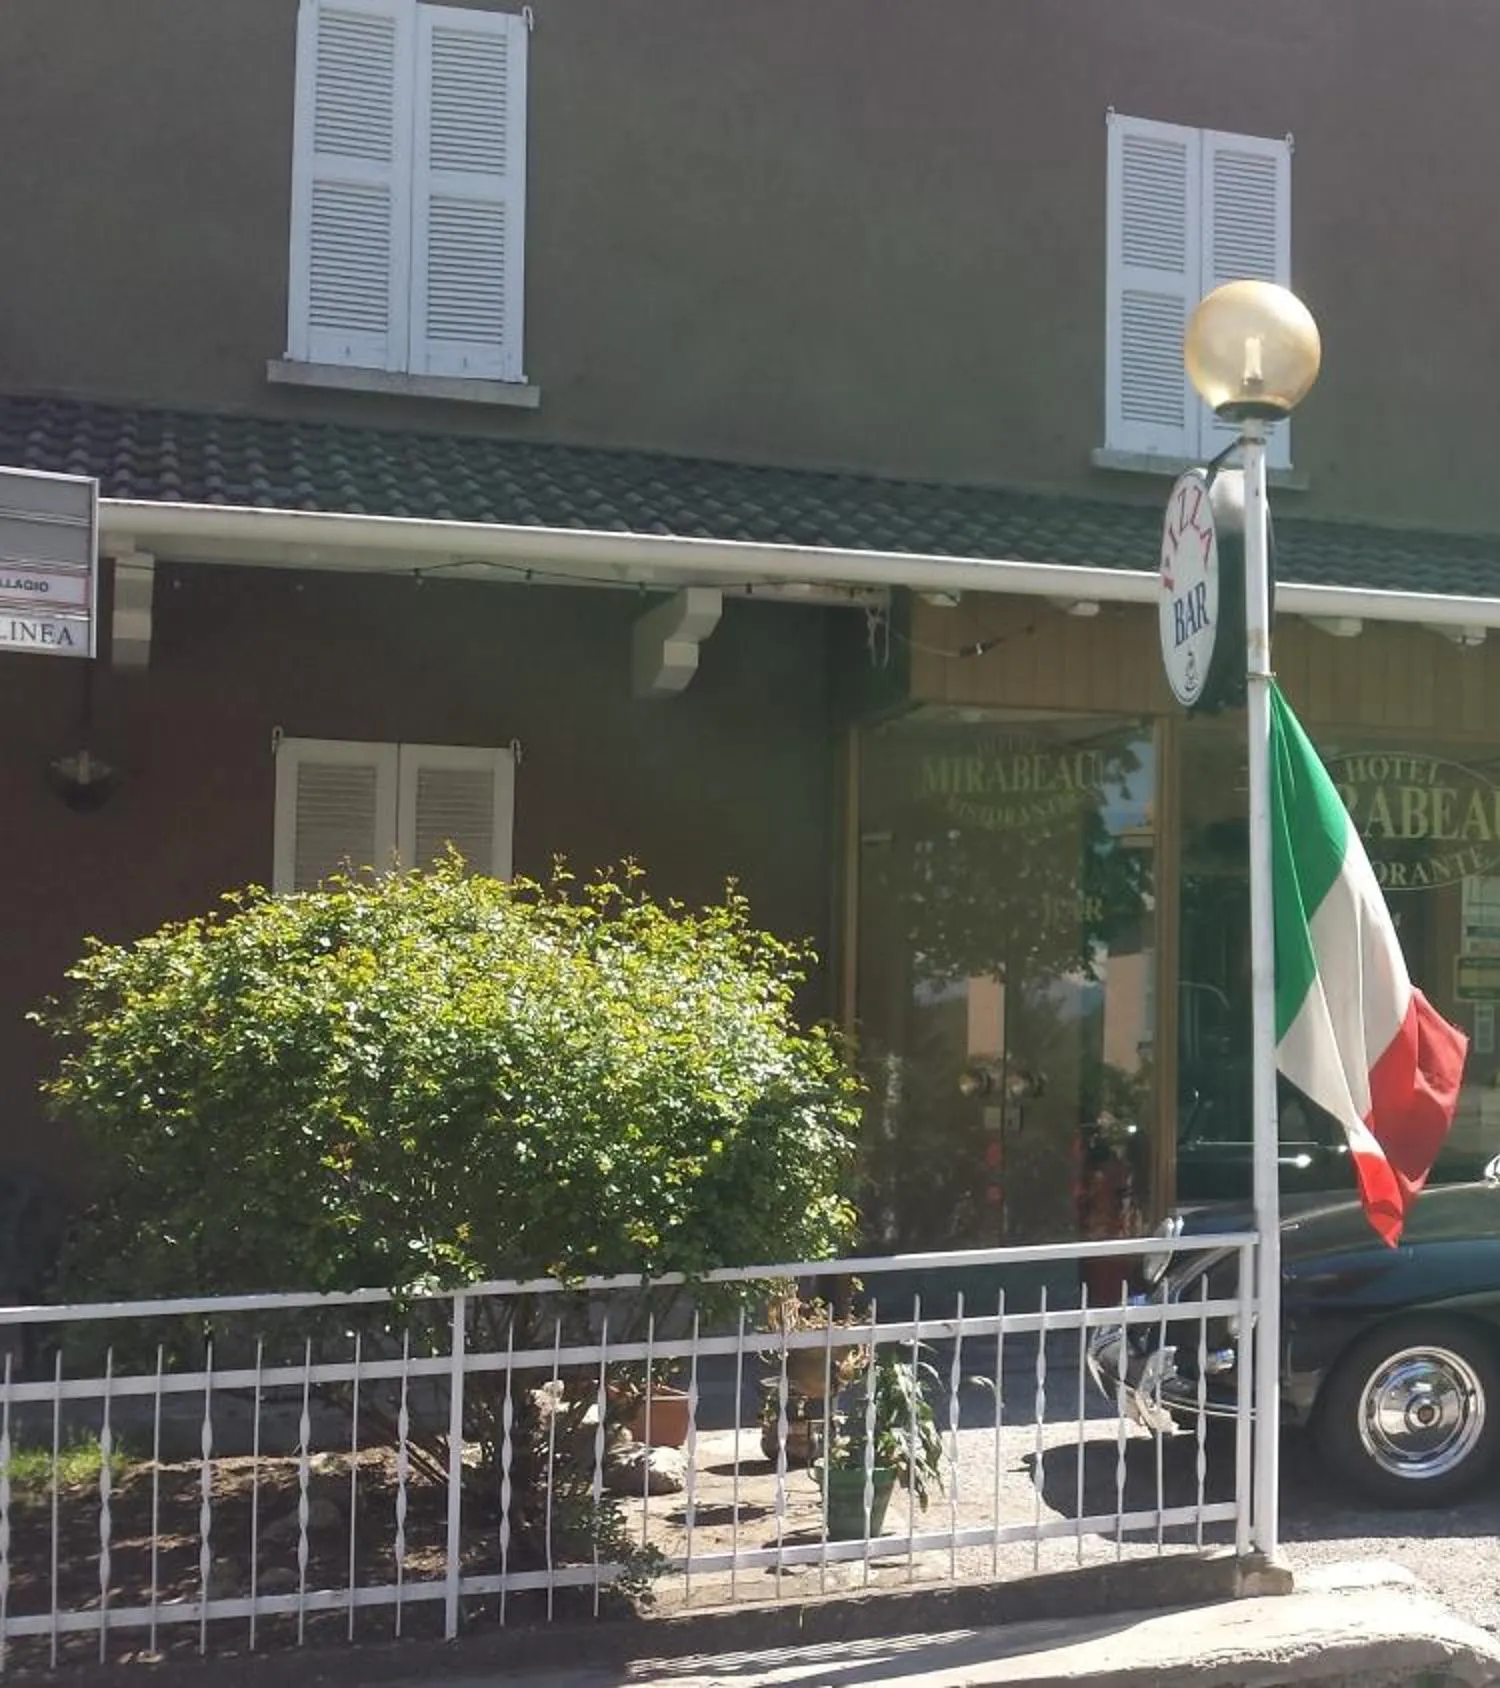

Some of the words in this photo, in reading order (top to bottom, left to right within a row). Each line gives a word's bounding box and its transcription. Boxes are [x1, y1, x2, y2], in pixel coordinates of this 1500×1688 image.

[1174, 581, 1210, 648] BAR
[920, 751, 1104, 794] MIRABEAU
[1346, 757, 1445, 786] HOTEL
